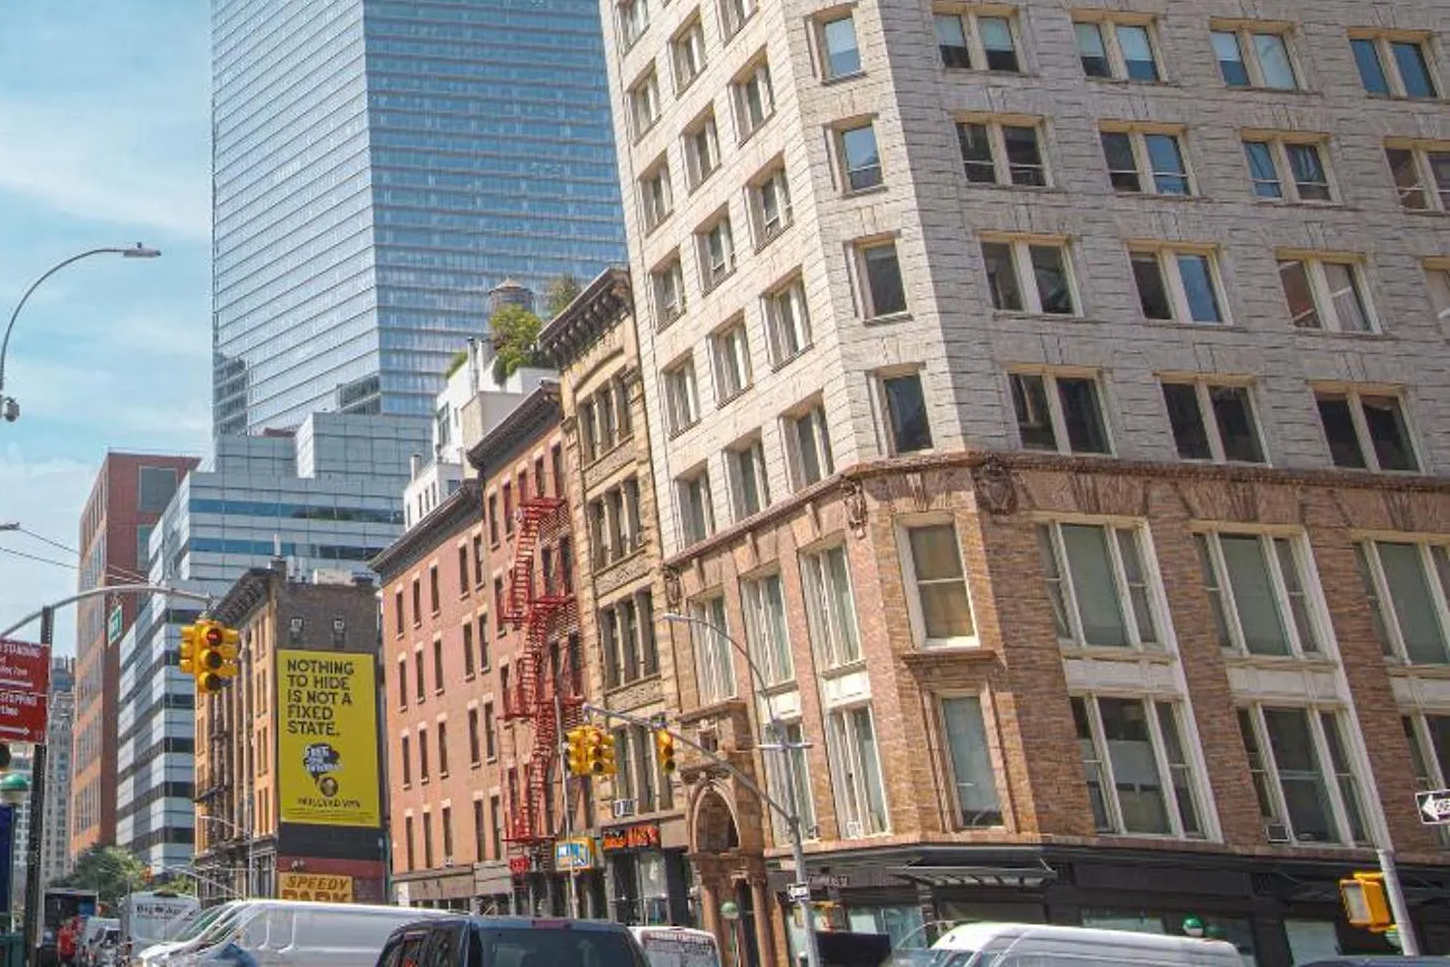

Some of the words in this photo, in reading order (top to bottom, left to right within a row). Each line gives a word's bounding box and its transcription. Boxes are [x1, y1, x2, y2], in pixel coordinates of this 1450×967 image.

[287, 659, 354, 675] NOTHING
[287, 674, 308, 687] TO
[313, 676, 351, 690] HIDE
[287, 689, 302, 702] IS
[307, 691, 338, 704] NOT
[341, 693, 353, 705] A
[287, 703, 333, 720] FIXED
[287, 720, 340, 736] STATE.
[287, 875, 349, 891] SPEEDY
